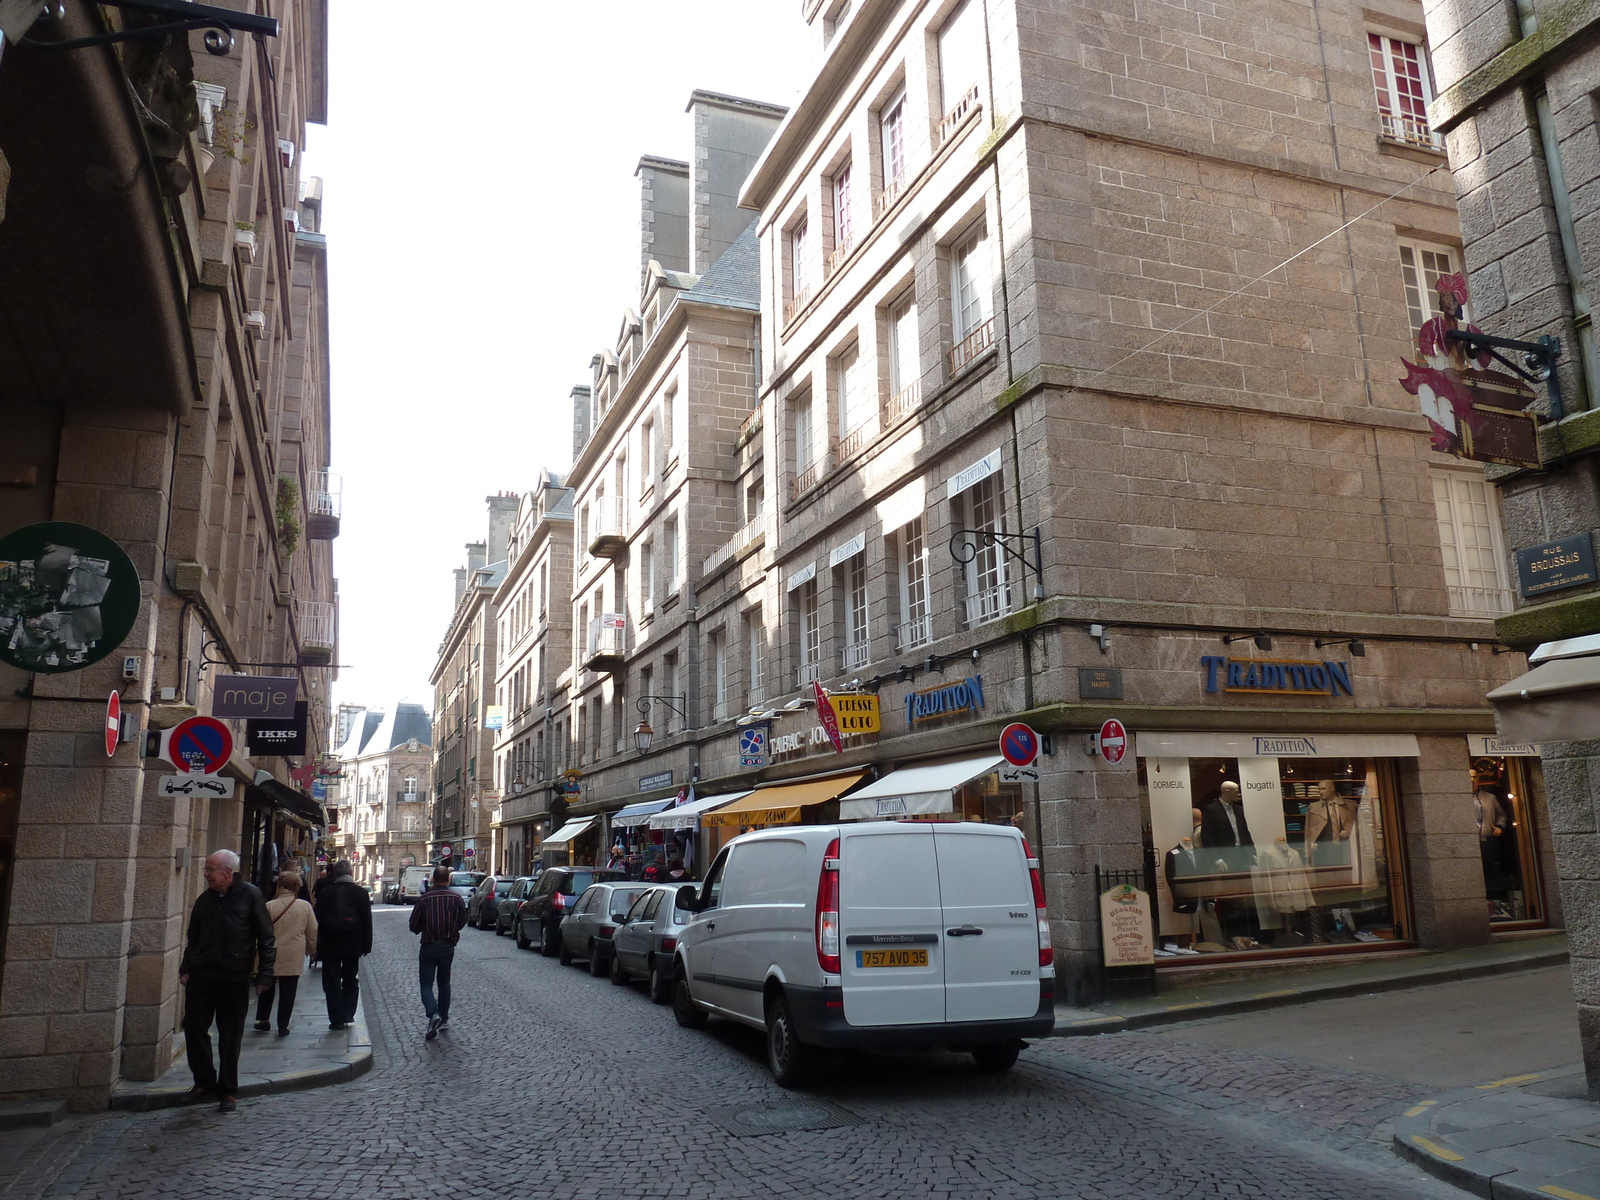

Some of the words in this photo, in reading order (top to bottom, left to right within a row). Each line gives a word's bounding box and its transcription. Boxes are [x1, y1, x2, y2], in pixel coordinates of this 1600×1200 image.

[955, 456, 992, 492] TRADITION
[1543, 545, 1563, 556] RUE
[1530, 551, 1580, 573] BROUSSAIS
[1201, 655, 1354, 697] TRADITION
[223, 686, 288, 713] maje
[838, 699, 874, 712] PRESSE
[904, 674, 985, 724] TRADITION
[817, 694, 839, 741] TABAC
[842, 715, 874, 729] LOTO
[257, 730, 298, 739] IKKS
[769, 731, 803, 755] TABAC
[1252, 736, 1318, 756] TRADITION
[741, 757, 763, 765] LOTO
[1153, 780, 1185, 789] DORMEUIL
[1246, 780, 1275, 791] bugatti
[876, 796, 907, 816] TRADITION
[864, 952, 886, 965] 757
[889, 951, 910, 964] AVD
[911, 951, 926, 964] 35
